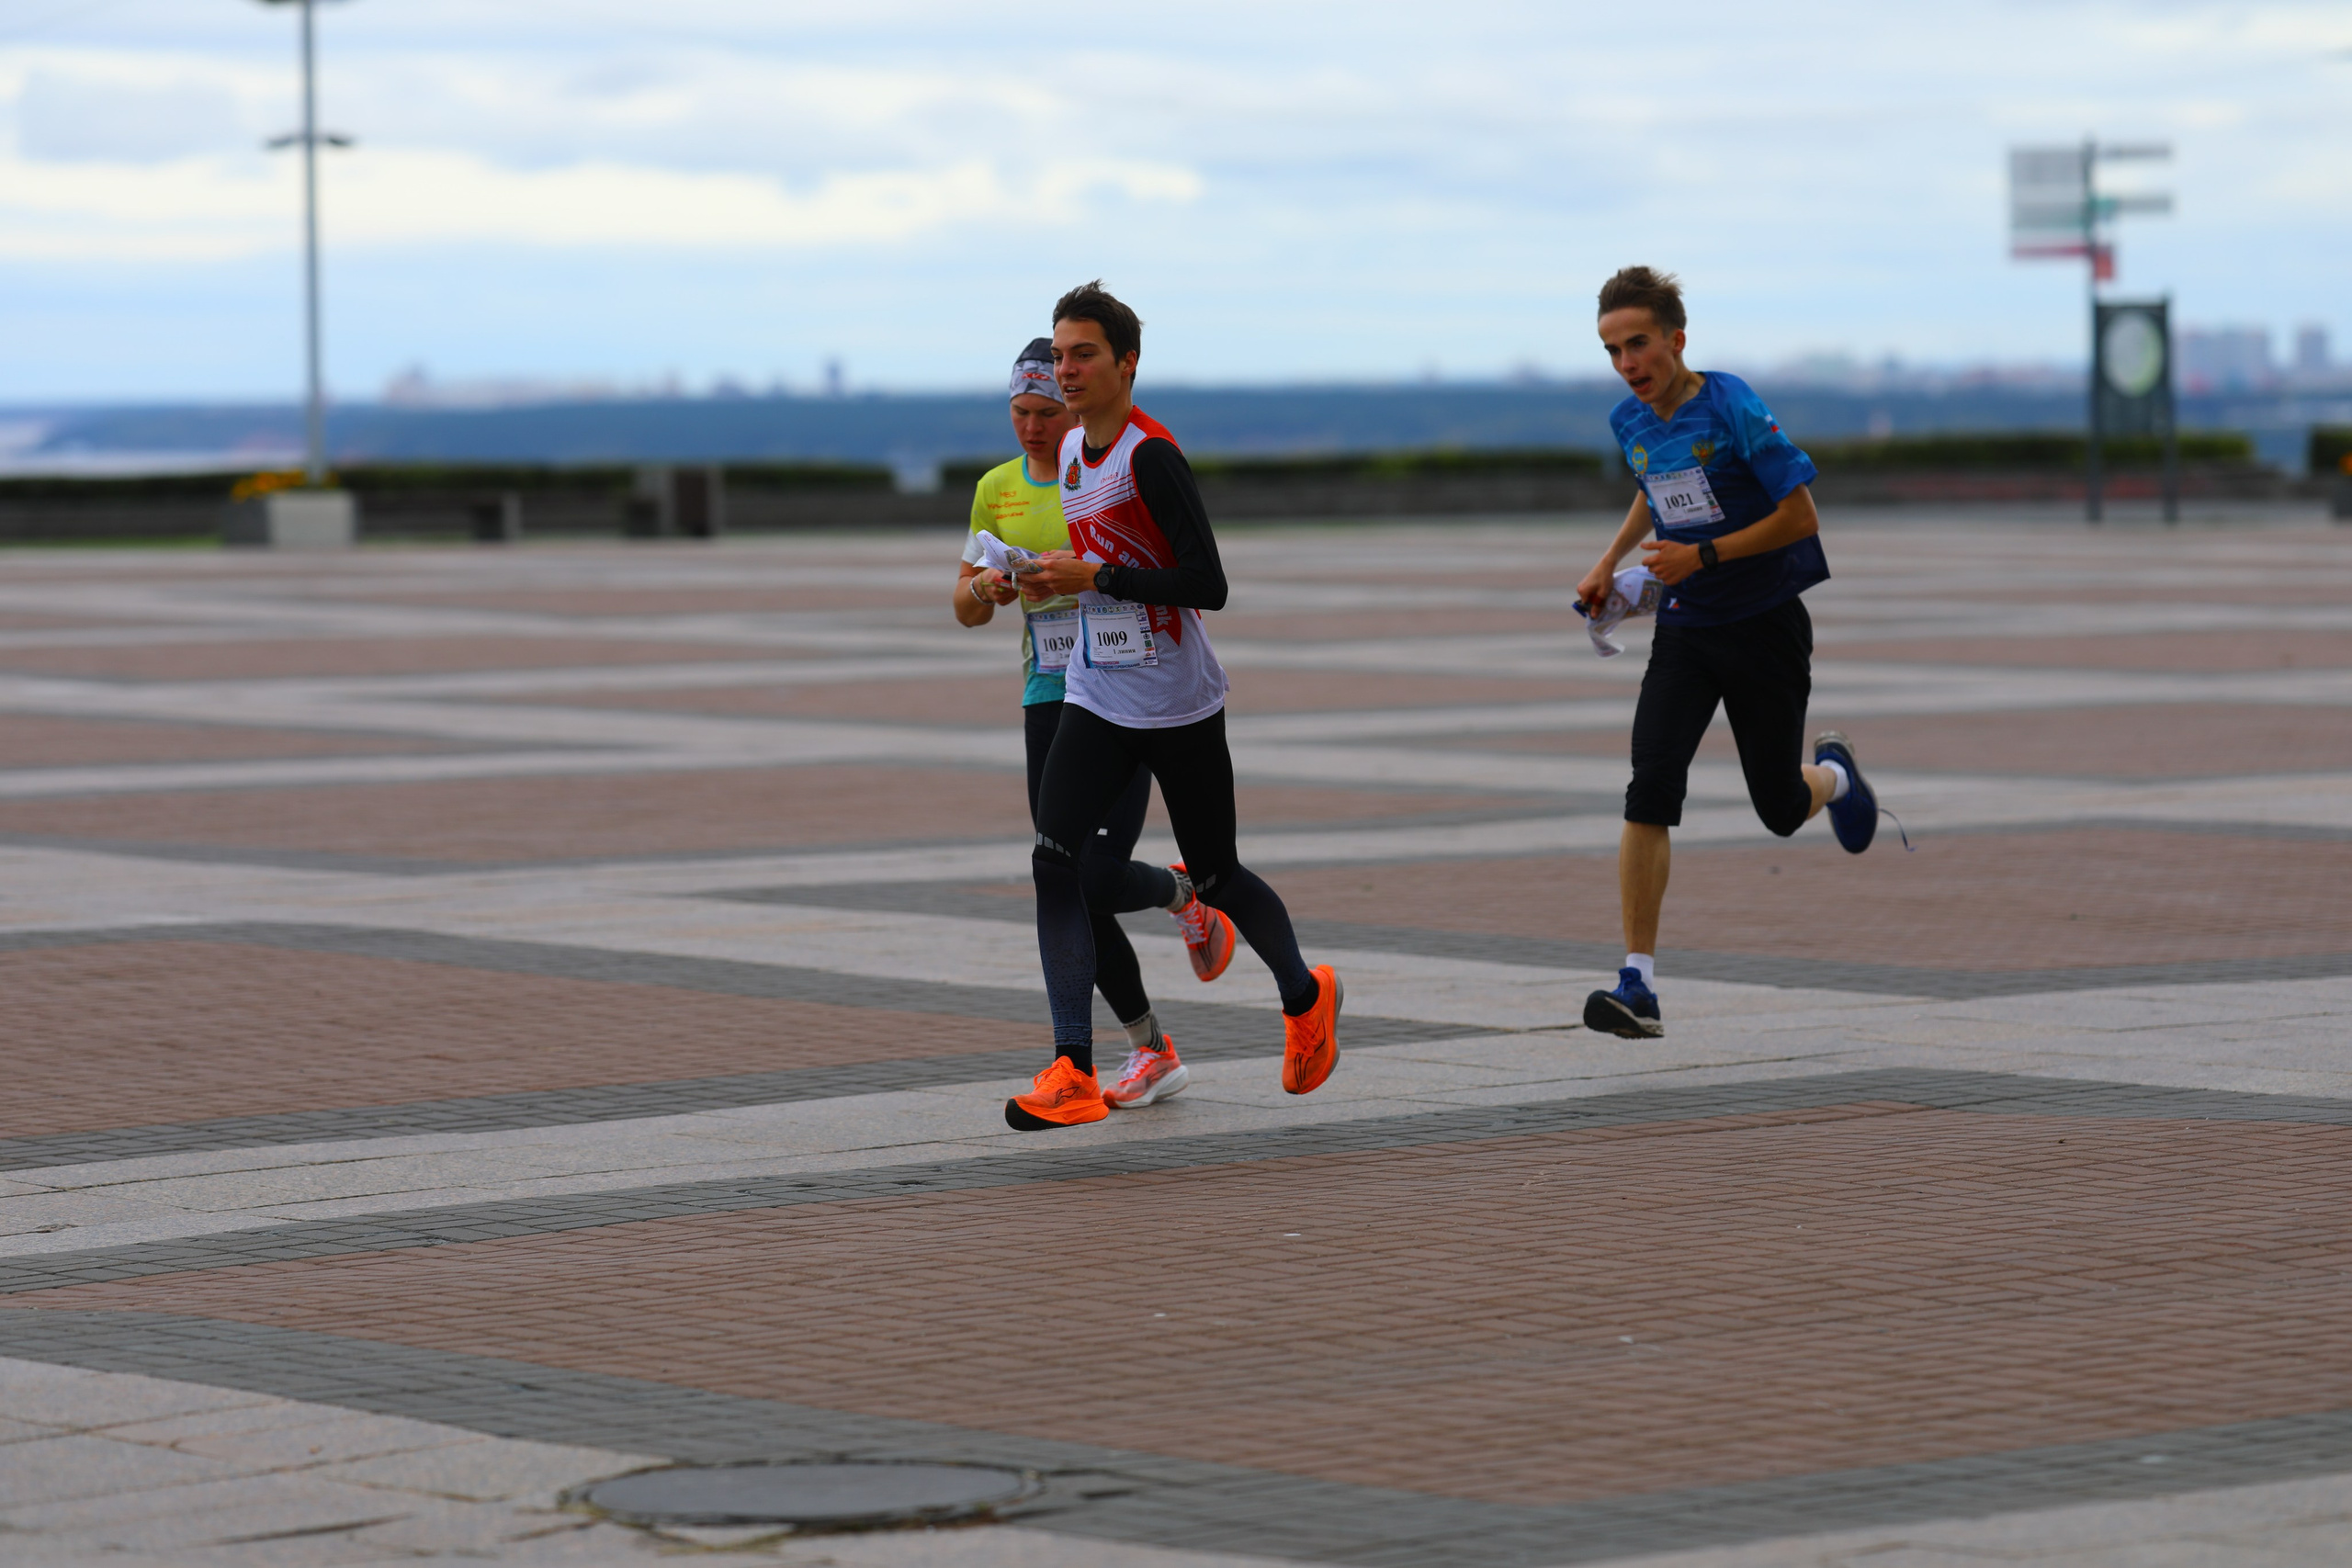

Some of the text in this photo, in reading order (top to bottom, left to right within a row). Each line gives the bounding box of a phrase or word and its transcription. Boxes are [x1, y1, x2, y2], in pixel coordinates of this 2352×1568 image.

[1664, 492, 1694, 510] 1021
[1089, 524, 1142, 569] Run an
[1043, 635, 1075, 652] 1030
[1096, 630, 1128, 647] 1009
